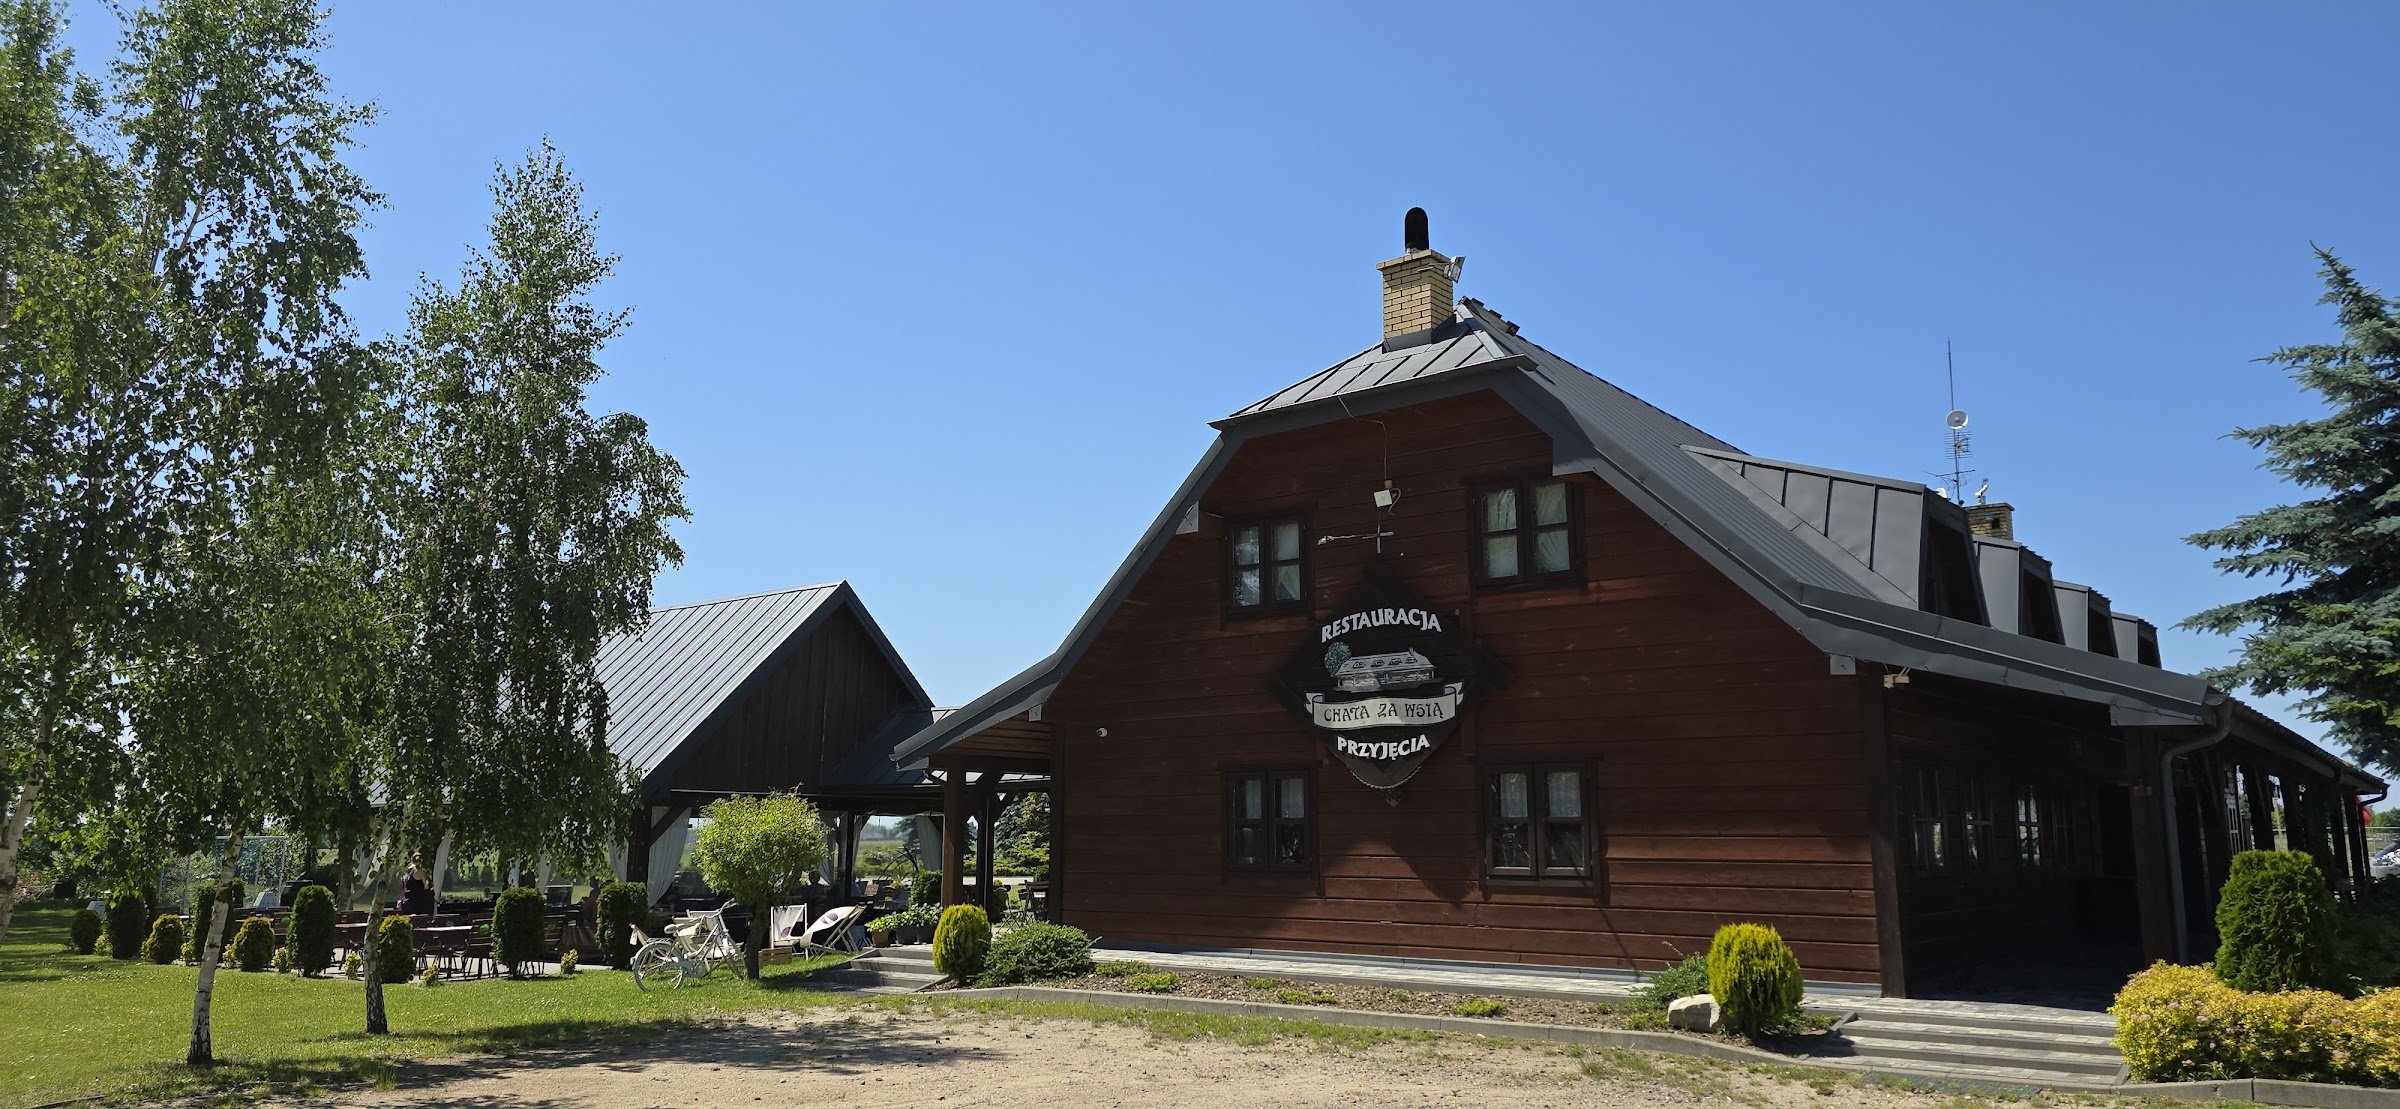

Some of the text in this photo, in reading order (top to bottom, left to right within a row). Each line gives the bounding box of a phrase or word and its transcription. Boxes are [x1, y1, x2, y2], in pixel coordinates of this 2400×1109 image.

[1321, 607, 1442, 643] RESTAURACJA
[1324, 705, 1370, 722] CHATA
[1377, 703, 1398, 718] ZA
[1337, 734, 1430, 761] PRZYJĘCIA
